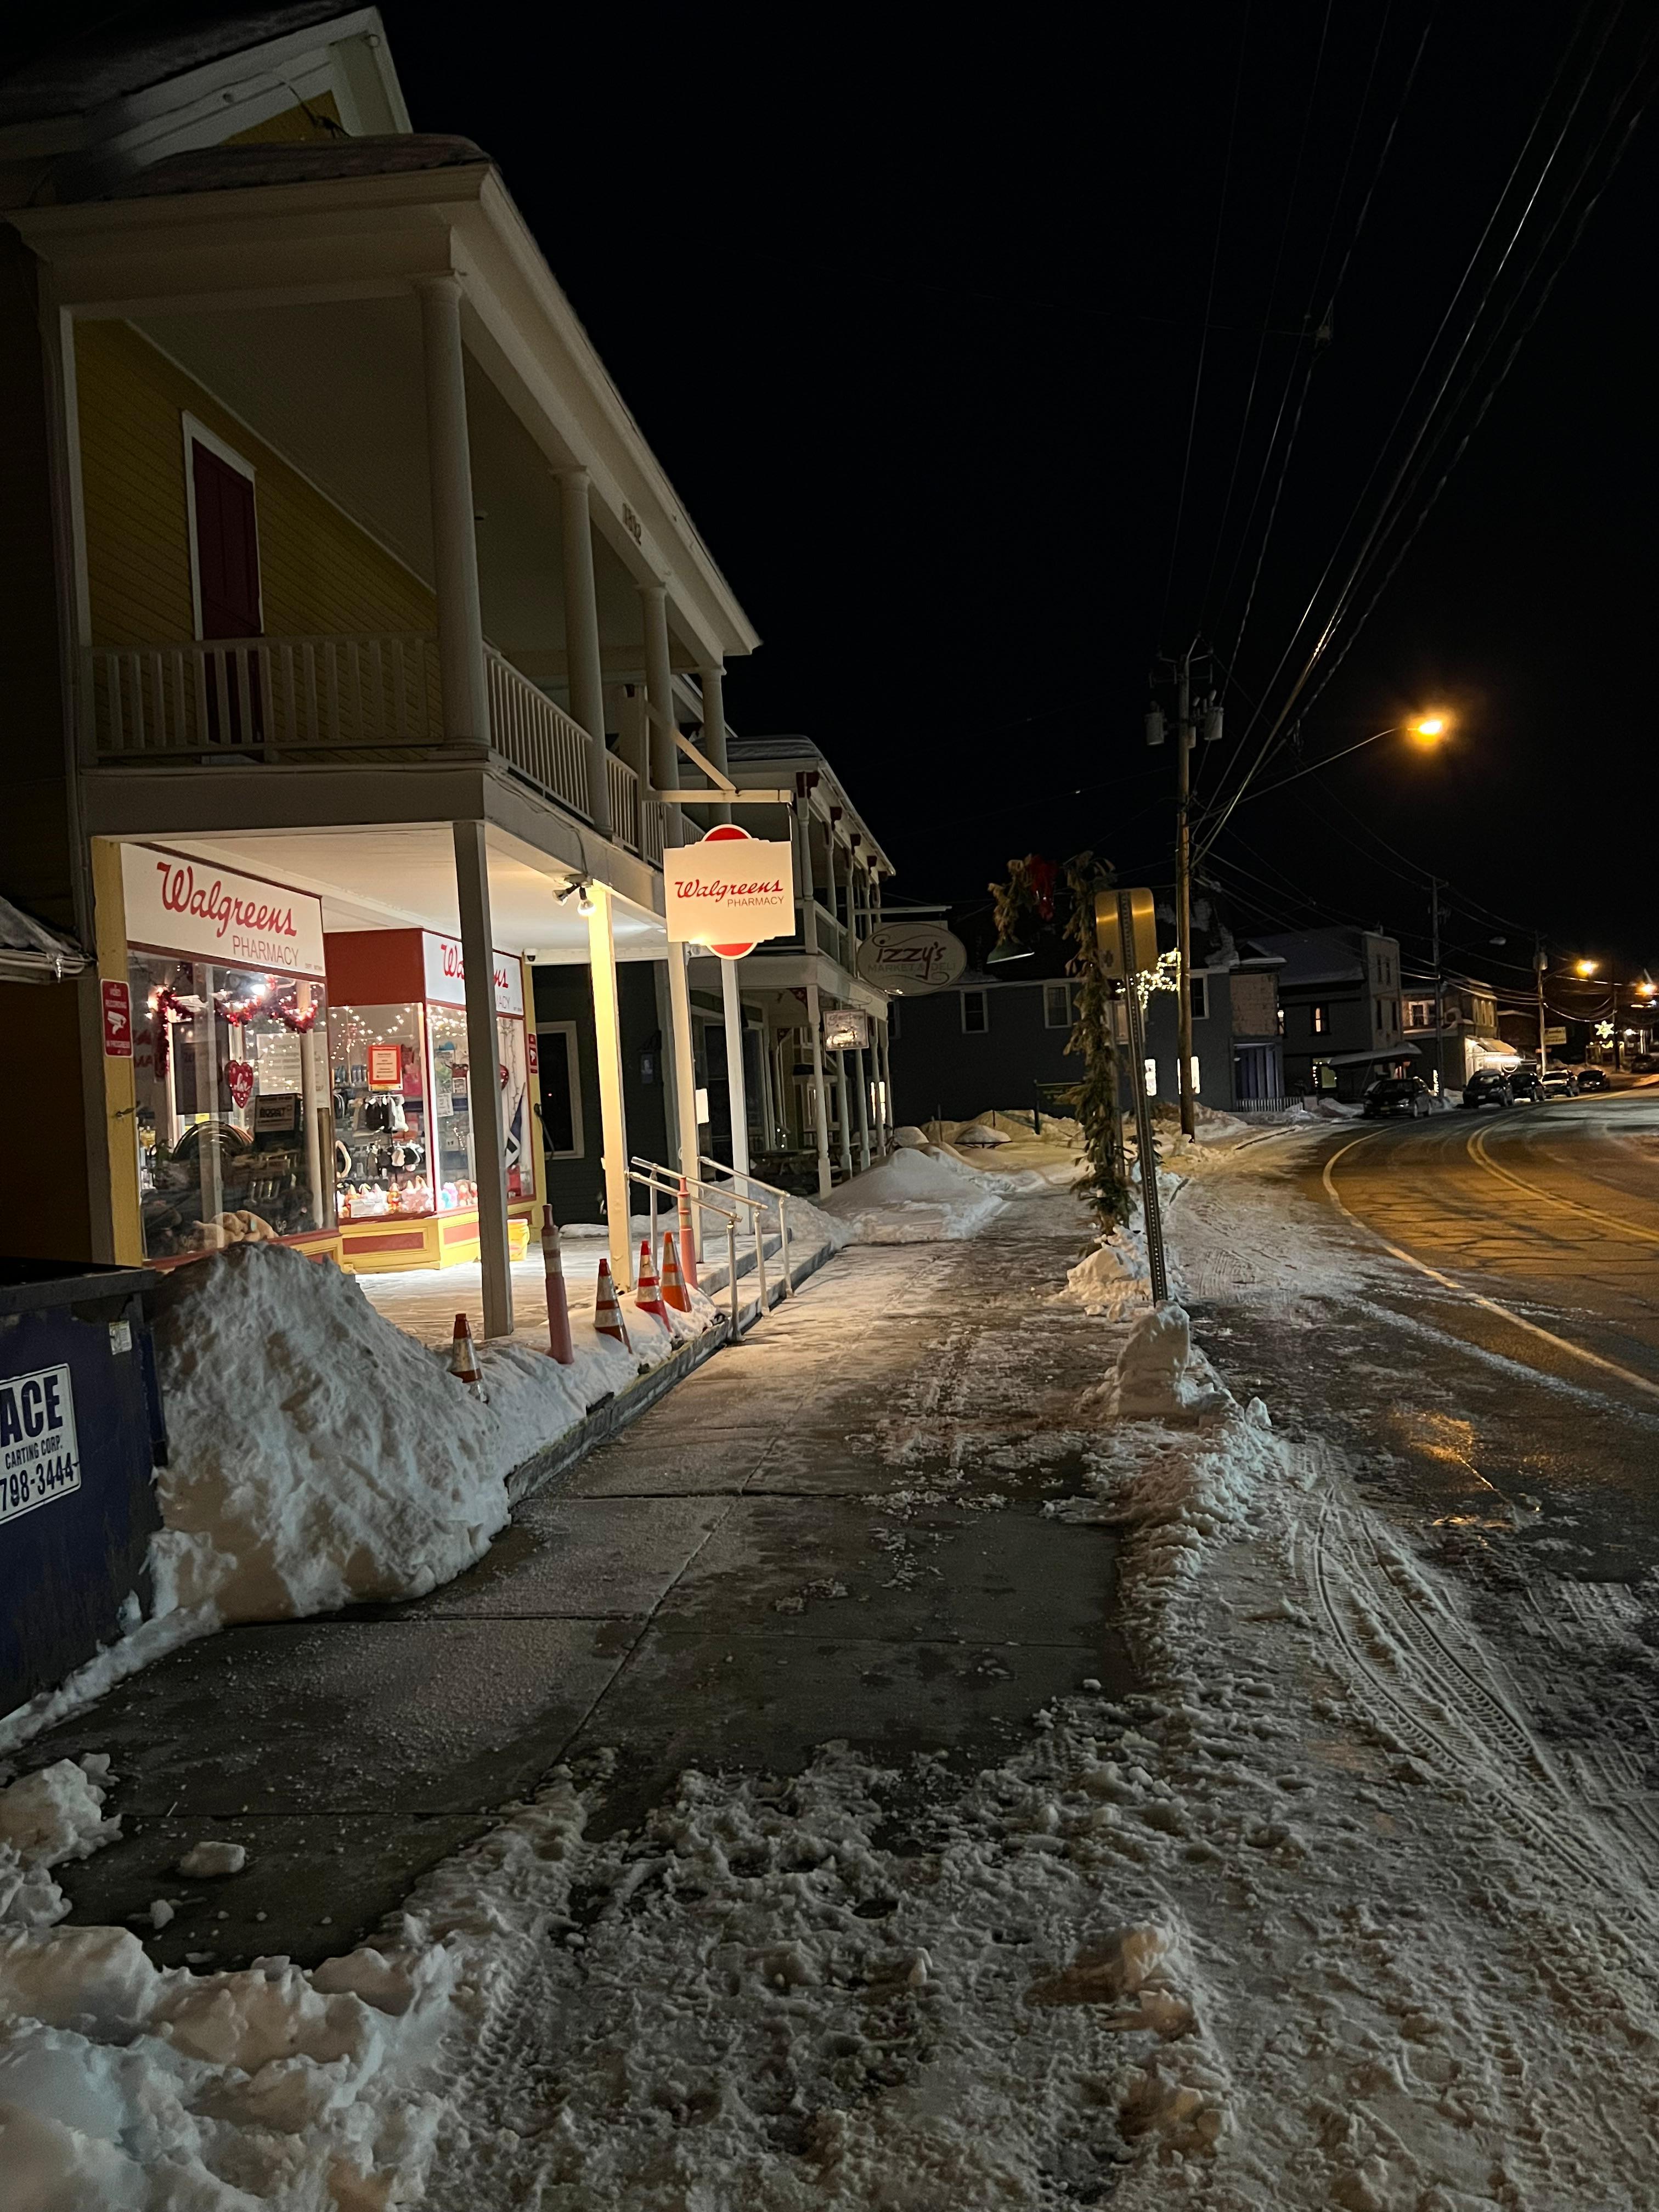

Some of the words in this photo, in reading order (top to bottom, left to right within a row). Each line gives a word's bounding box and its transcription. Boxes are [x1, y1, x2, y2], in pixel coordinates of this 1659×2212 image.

[157, 861, 297, 937] Walgreens
[675, 879, 783, 902] Walgreens
[727, 895, 785, 907] PHARMACY
[233, 935, 299, 967] PHARMACY
[867, 964, 913, 973] MARKET
[931, 963, 957, 972] DELI
[0, 1375, 63, 1448] ACE
[5, 1442, 39, 1470] CARTING
[41, 1435, 64, 1456] CORP.
